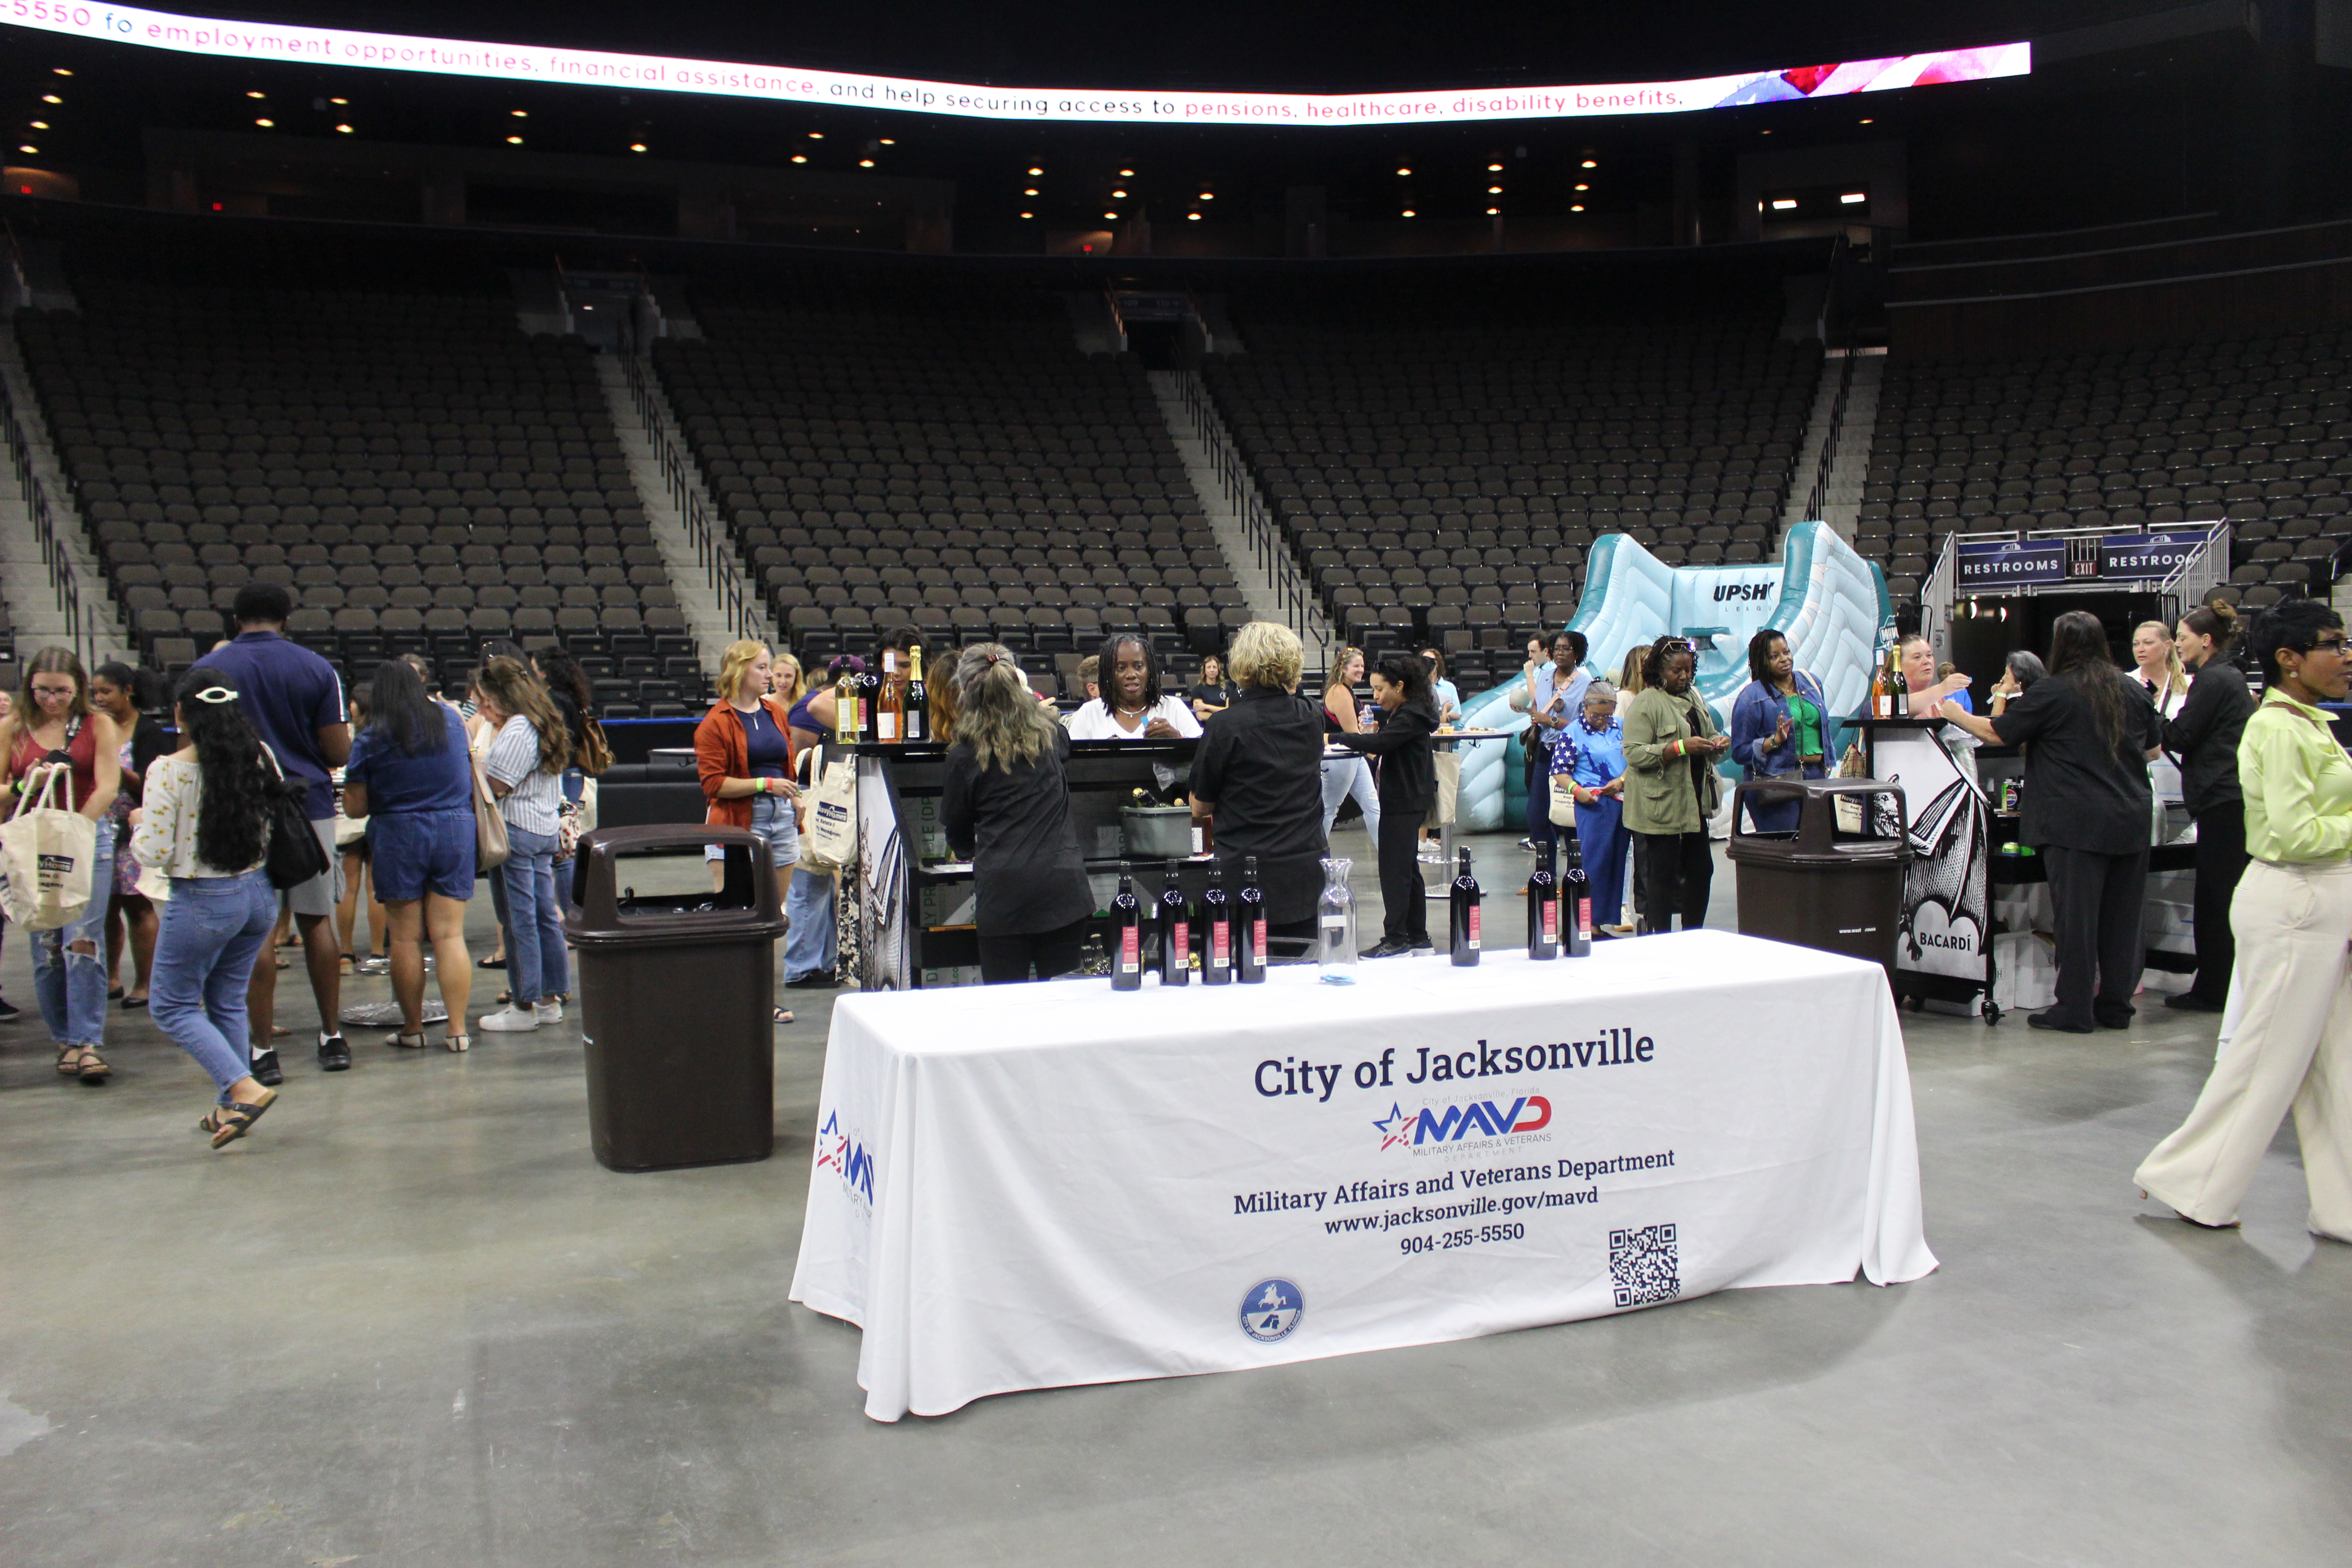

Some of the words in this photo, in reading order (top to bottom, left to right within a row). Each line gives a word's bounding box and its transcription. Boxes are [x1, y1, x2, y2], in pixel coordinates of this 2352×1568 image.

[147, 24, 332, 55] employment
[345, 40, 539, 73] opportunities,
[550, 56, 665, 81] financial
[676, 69, 819, 94] assistance,
[830, 82, 874, 99] and
[885, 87, 935, 106] help
[946, 93, 1049, 115] securing
[1059, 96, 1142, 114] access
[1153, 98, 1175, 114] to
[1186, 101, 1297, 118] pensions,
[1307, 100, 1443, 118] healthcare,
[1453, 93, 1566, 113] disability
[1576, 90, 1682, 108] benefits,
[1964, 559, 2058, 575] RESTROOMS
[2075, 563, 2093, 575] EXIT
[1713, 582, 1775, 602] UPSH
[1920, 932, 1970, 951] BACARDÍ
[1255, 1057, 1342, 1102] City
[1355, 1048, 1395, 1089] of
[1406, 1028, 1654, 1084] Jacksonville
[1422, 1098, 1439, 1106] City
[1454, 1091, 1508, 1102] Jacksonville,
[1511, 1087, 1540, 1096] Florida
[1413, 1096, 1552, 1145] MAVD
[1413, 1145, 1454, 1157] MILITARY
[1456, 1140, 1493, 1151] AFFAIRS
[1496, 1138, 1502, 1147] &
[1504, 1134, 1552, 1146] VETERANS
[1444, 1147, 1522, 1162] DEPARTMENT
[1234, 1191, 1327, 1214] Military
[1334, 1179, 1409, 1204] Affairs
[1416, 1171, 1454, 1195] and
[1460, 1164, 1551, 1189] Veterans
[1558, 1150, 1675, 1180] Department
[1325, 1186, 1598, 1235] www.jacksonville.gov/mavd
[1401, 1222, 1524, 1255] 904-255-5550
